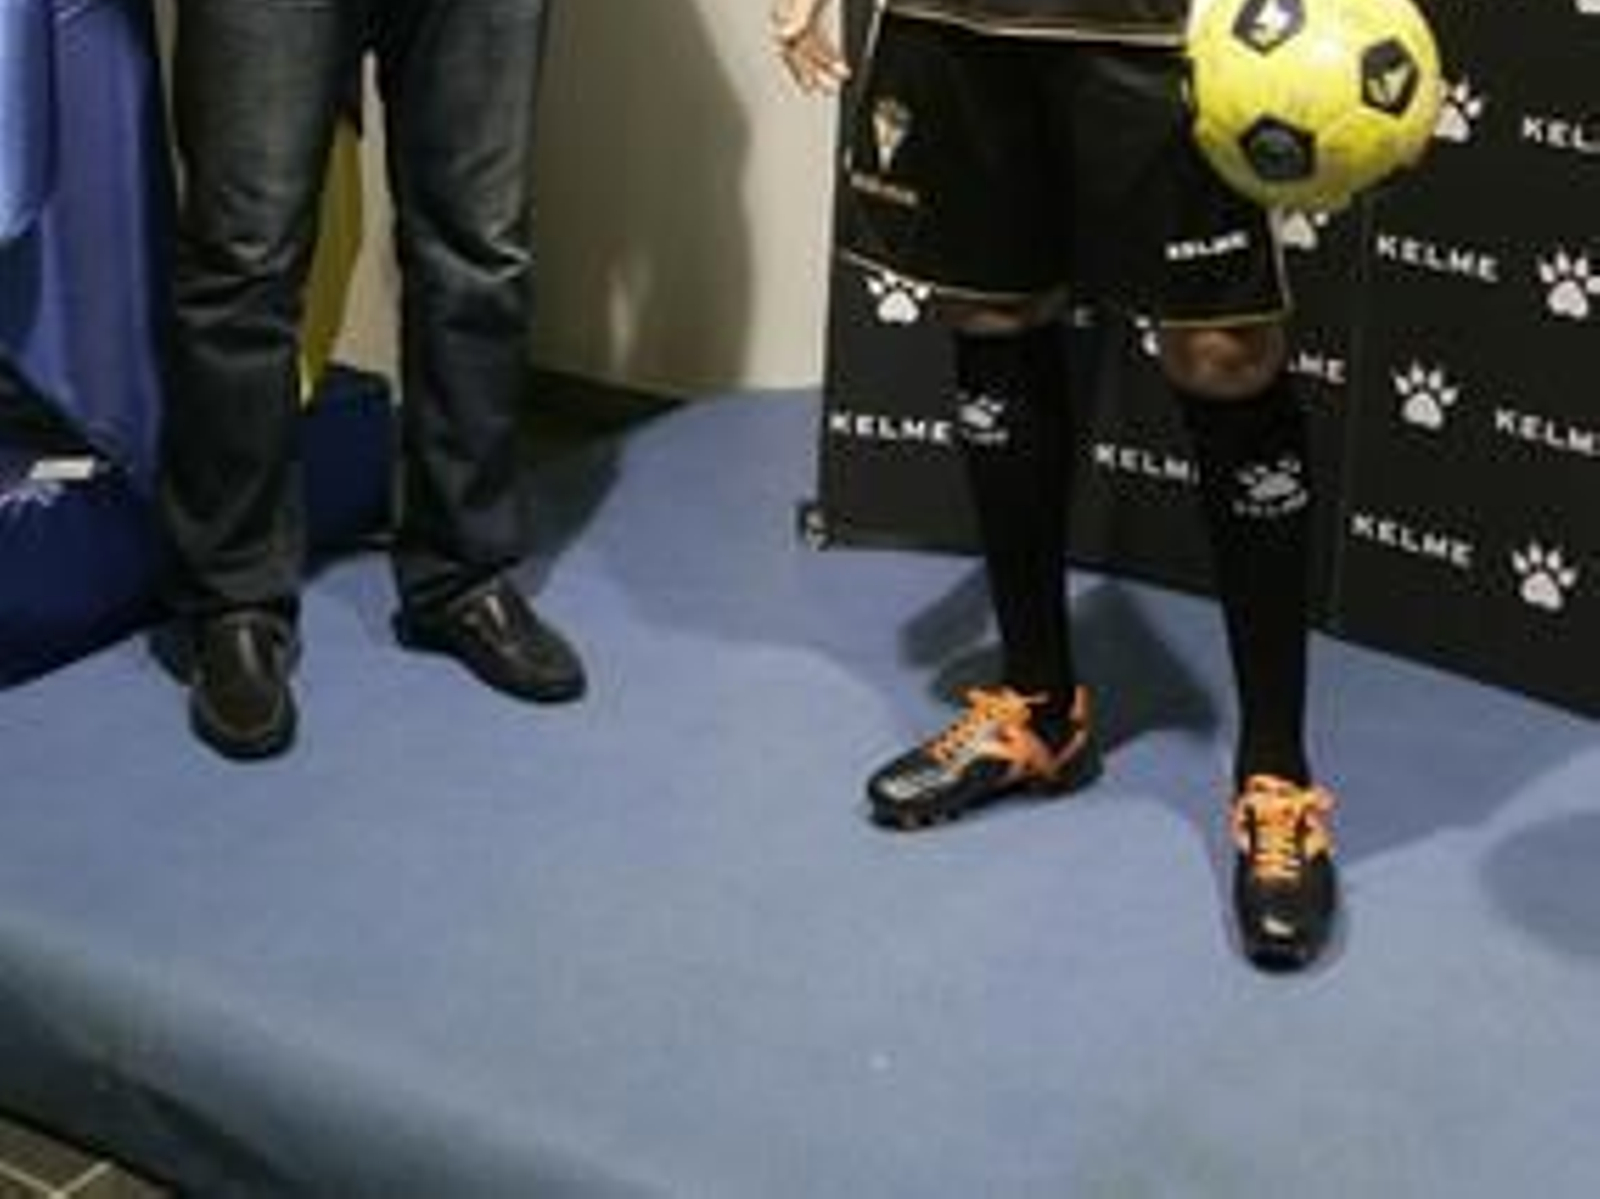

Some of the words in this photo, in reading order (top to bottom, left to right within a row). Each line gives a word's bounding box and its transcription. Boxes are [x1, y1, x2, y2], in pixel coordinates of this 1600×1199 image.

[1522, 117, 1600, 153] KEL
[1376, 235, 1499, 282] KELME
[829, 413, 951, 443] KELME
[1095, 443, 1199, 485] KELM
[1353, 514, 1474, 567] KELME
